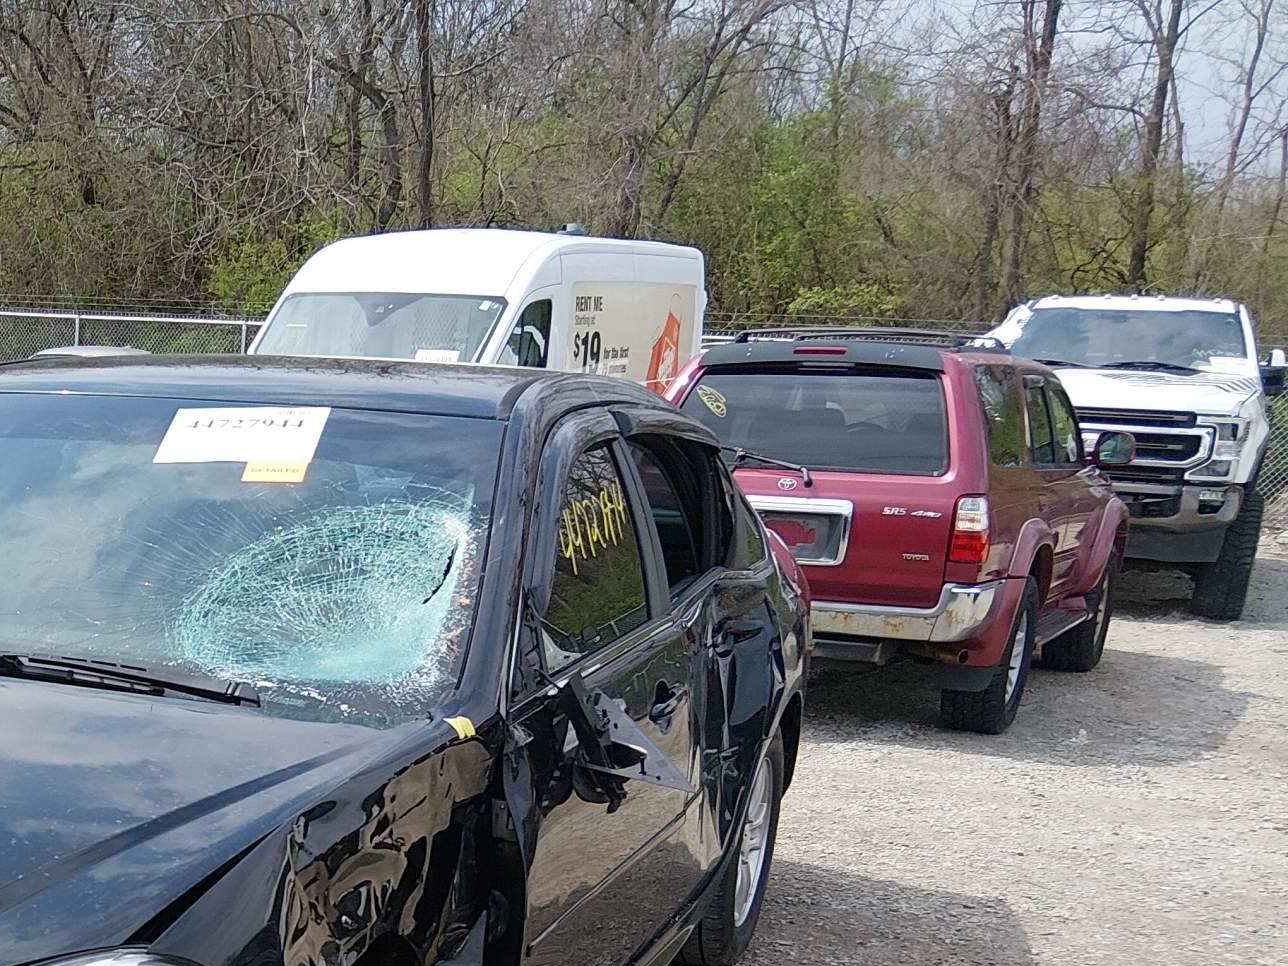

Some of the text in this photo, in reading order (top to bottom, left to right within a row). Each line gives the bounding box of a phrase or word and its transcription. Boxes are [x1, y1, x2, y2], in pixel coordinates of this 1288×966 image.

[576, 296, 603, 312] RENT ME
[573, 331, 601, 372] $19
[882, 507, 907, 516] SR5
